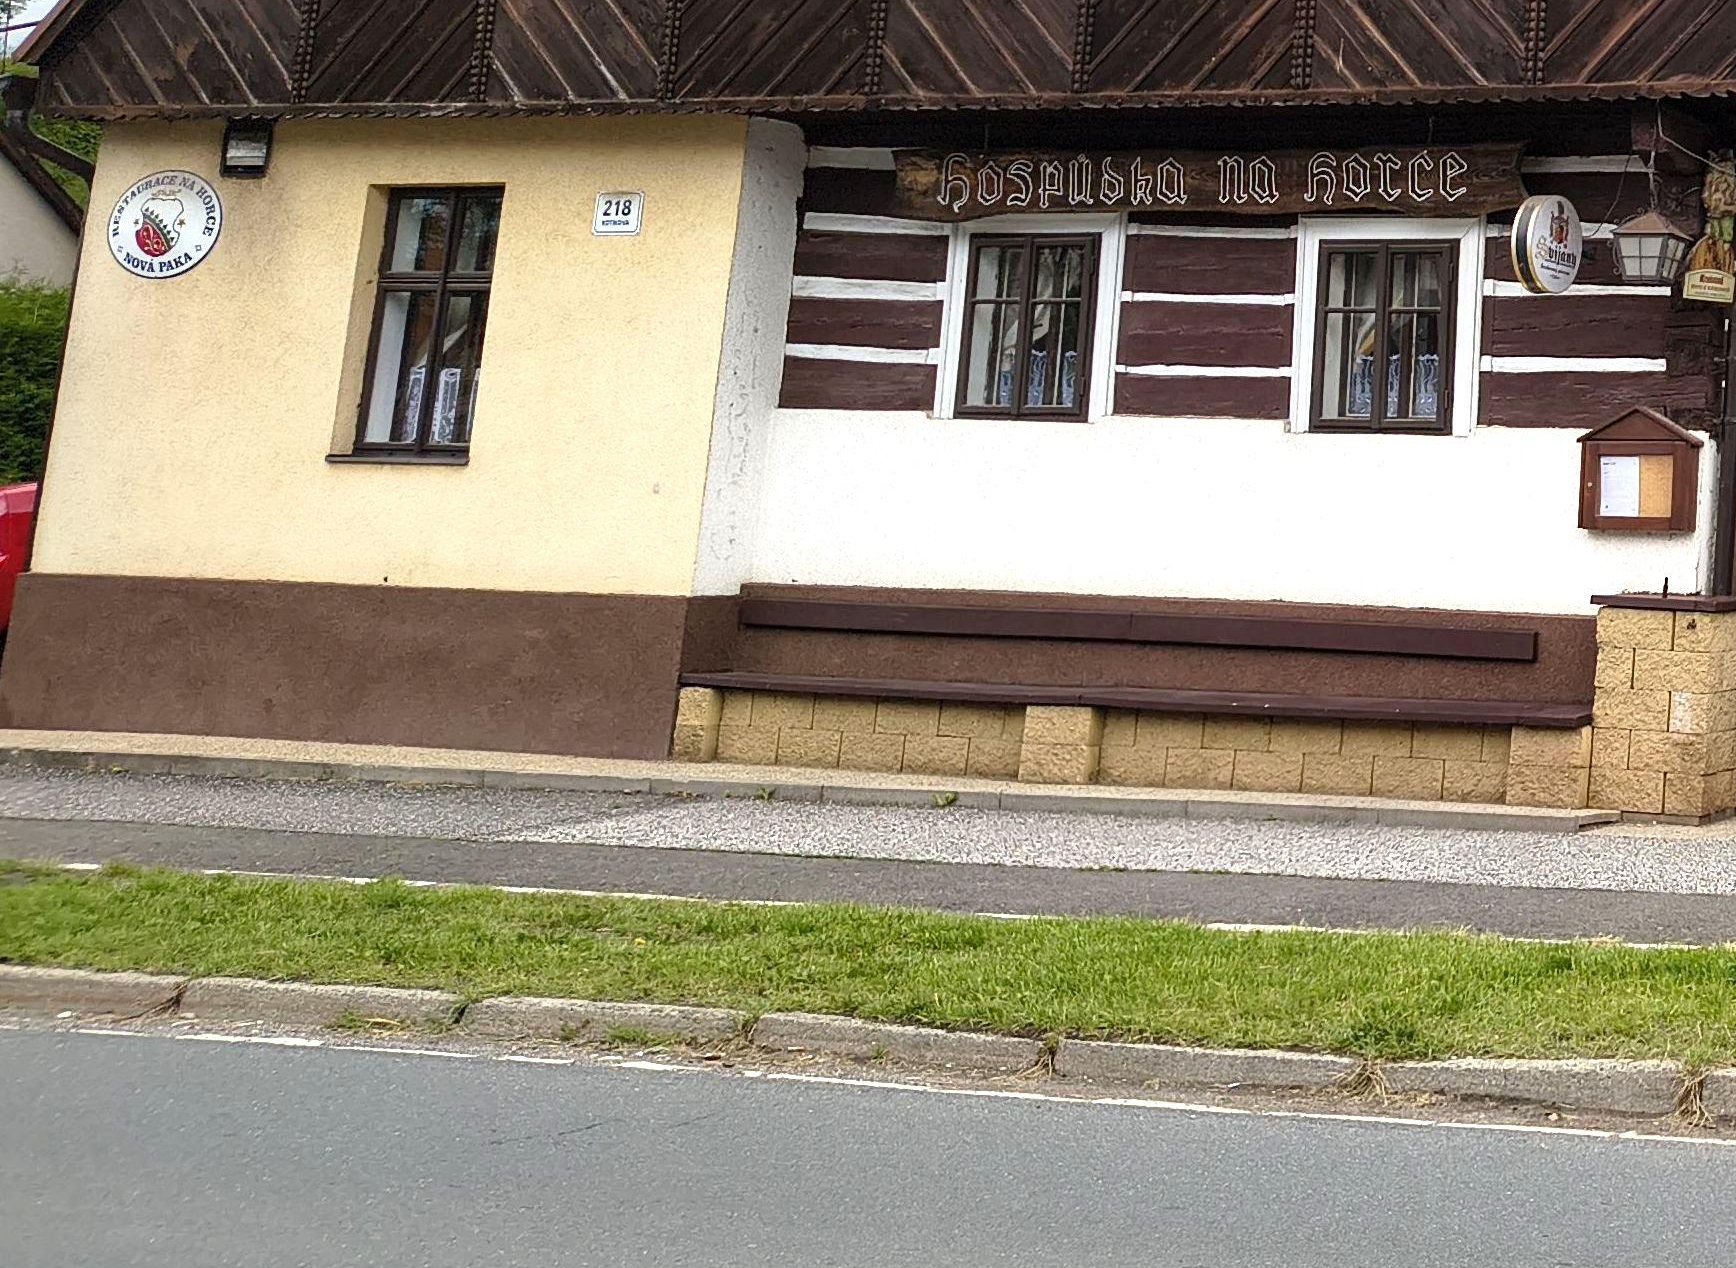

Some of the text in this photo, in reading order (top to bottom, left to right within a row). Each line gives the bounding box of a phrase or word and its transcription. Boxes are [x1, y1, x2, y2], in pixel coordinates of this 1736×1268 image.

[1217, 156, 1279, 203] na
[112, 175, 217, 238] RESTAURACE NA HORCE
[602, 199, 633, 217] 218
[123, 251, 193, 273] NOVÁ PAKA
[1535, 235, 1577, 269] Svijany
